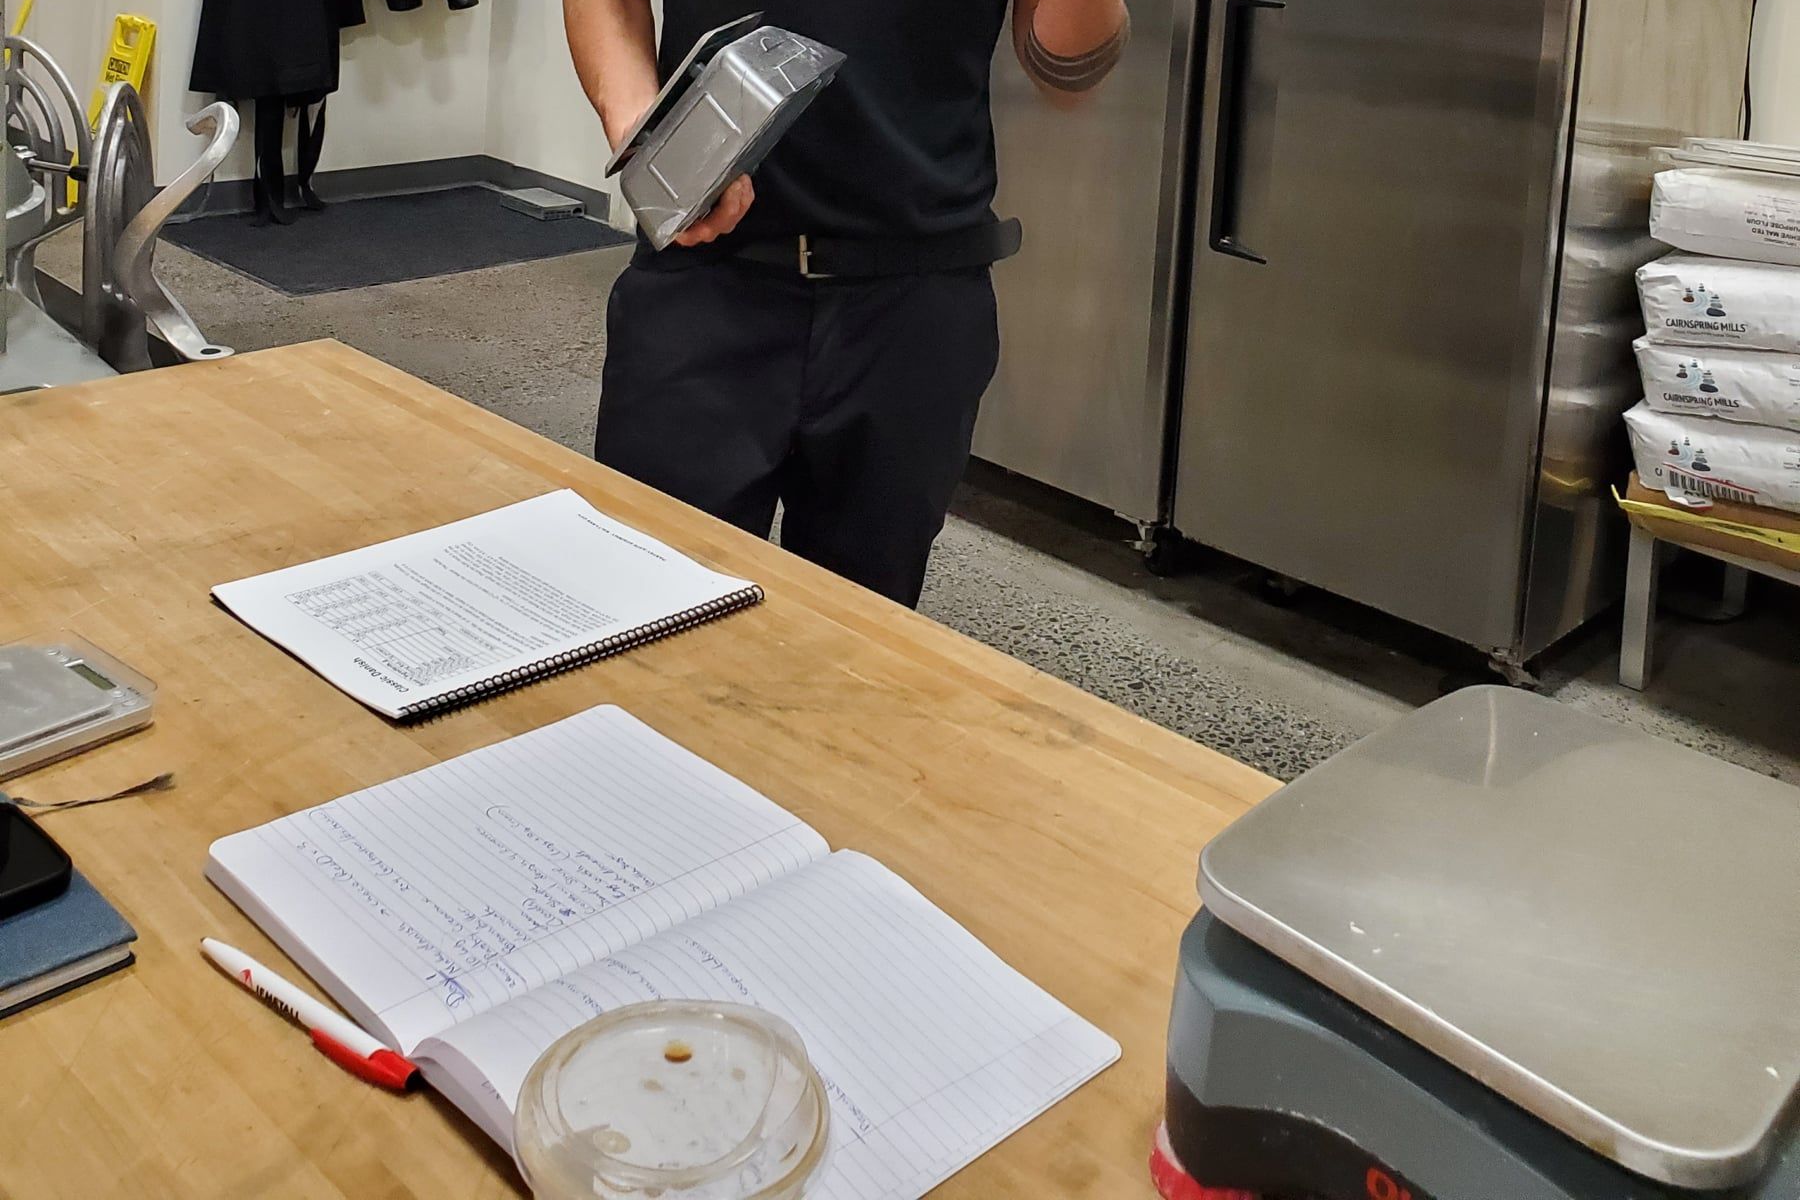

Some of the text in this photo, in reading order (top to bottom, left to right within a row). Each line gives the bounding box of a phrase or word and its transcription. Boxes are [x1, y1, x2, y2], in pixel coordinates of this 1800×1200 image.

[1747, 218, 1769, 228] FLOUR
[1752, 227, 1780, 238] MALTED
[1666, 318, 1746, 332] CAIRNSPRING MILLS
[1663, 393, 1713, 406] CAIRNSPRING
[1714, 397, 1739, 408] MILLS
[354, 657, 410, 693] Classic Danish
